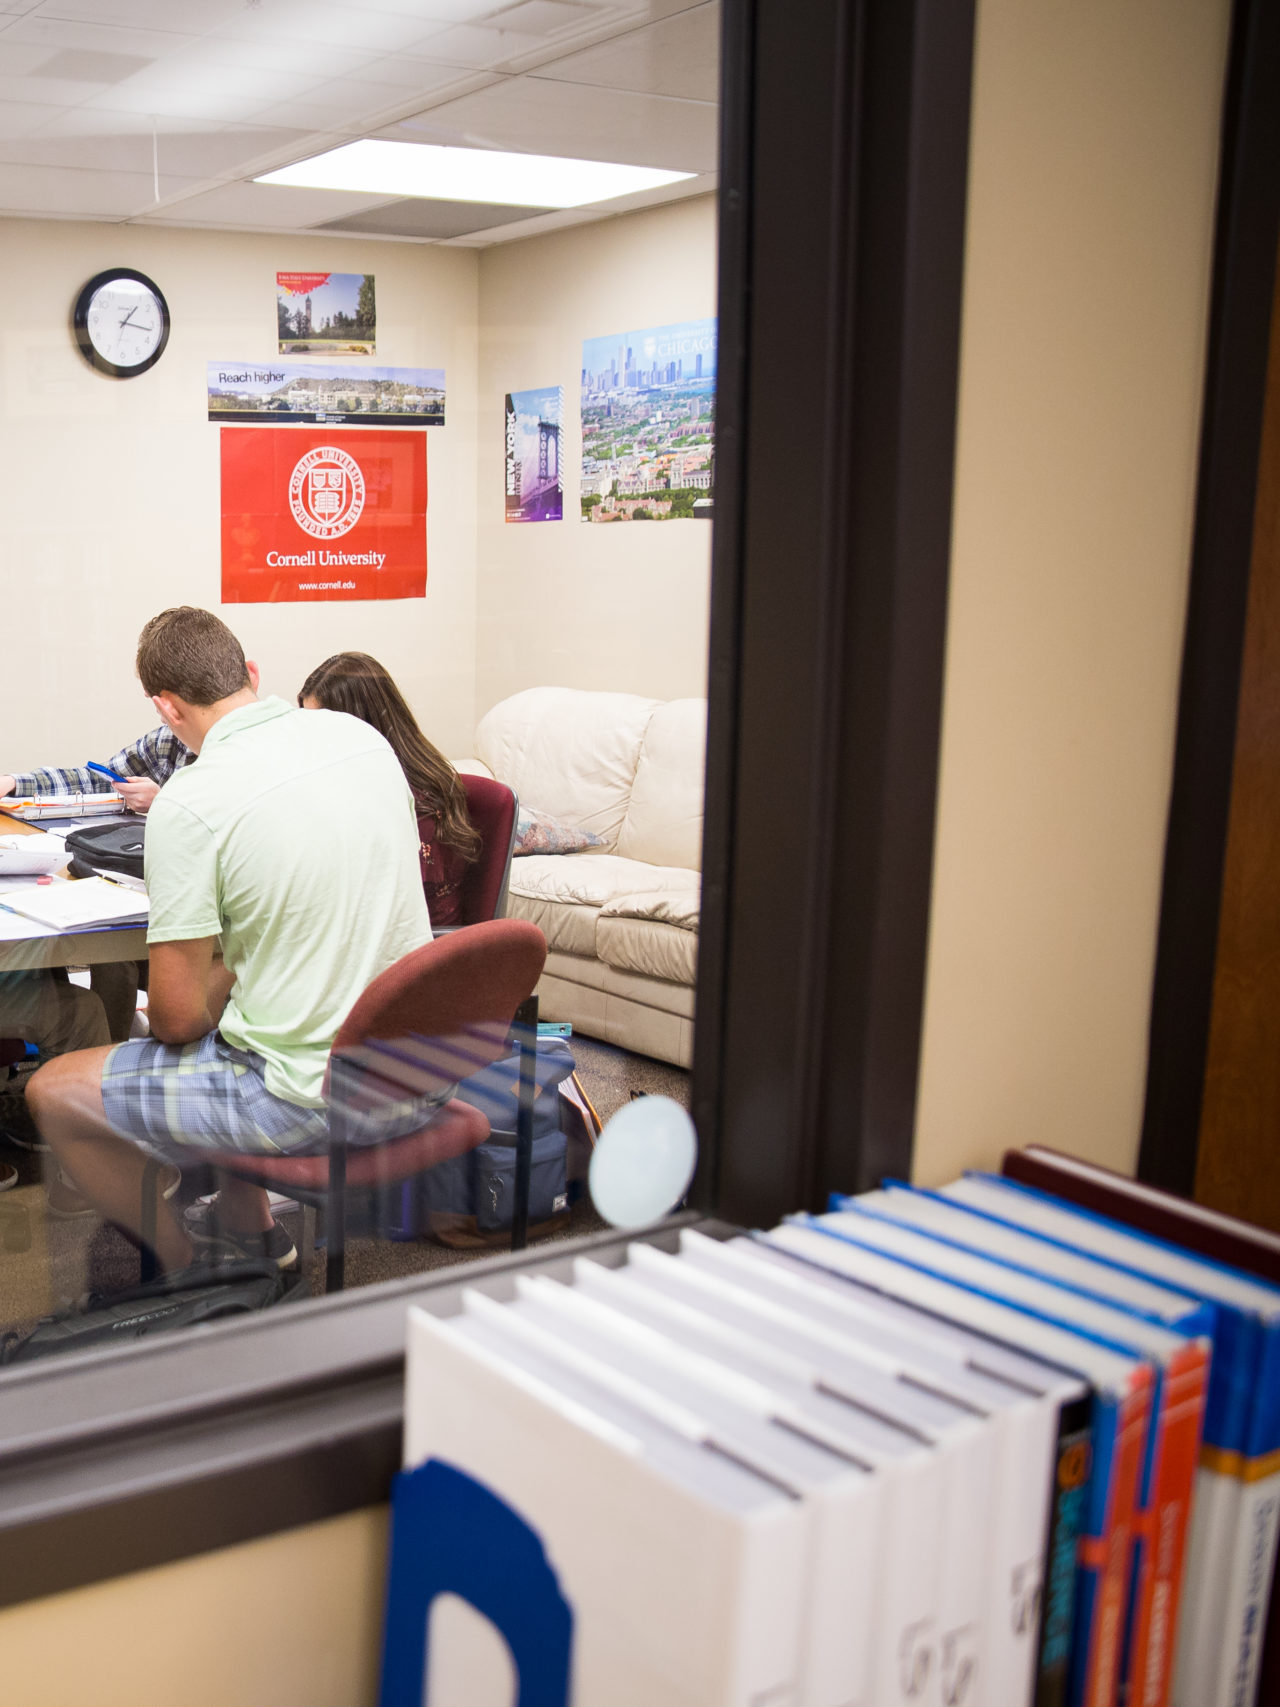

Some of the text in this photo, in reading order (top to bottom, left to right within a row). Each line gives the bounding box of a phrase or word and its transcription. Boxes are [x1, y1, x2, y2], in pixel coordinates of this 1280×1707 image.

[218, 371, 286, 385] Reach higher
[506, 411, 516, 495] NEW YORK
[292, 450, 363, 494] CORNELL UNIVERSITY
[292, 499, 328, 536] FOUNDED
[266, 550, 386, 570] Cornell University
[298, 580, 356, 590] www.cornell.edu
